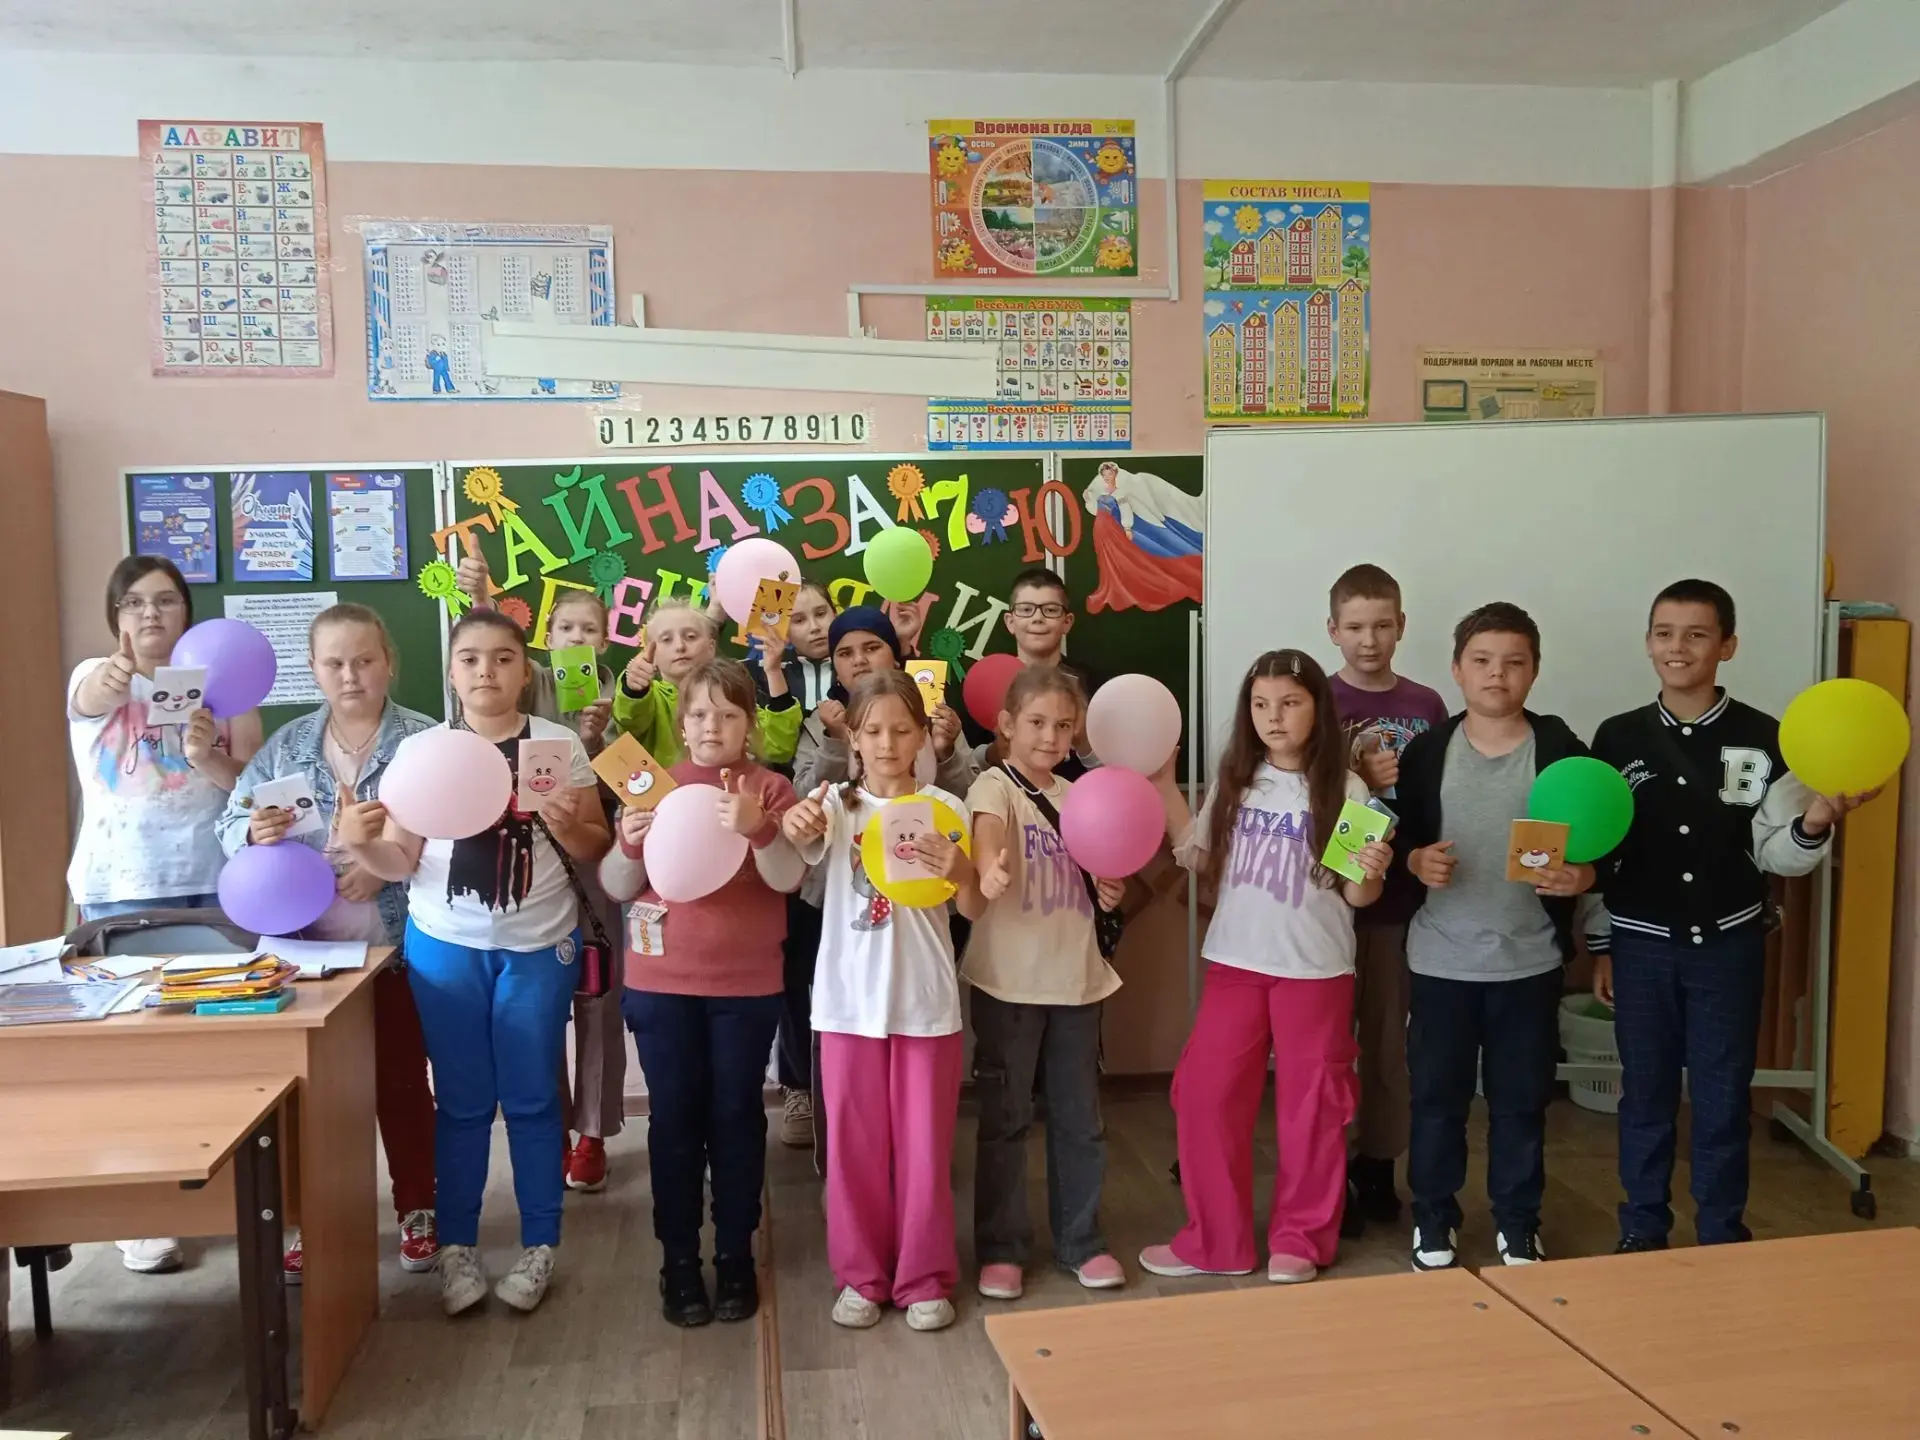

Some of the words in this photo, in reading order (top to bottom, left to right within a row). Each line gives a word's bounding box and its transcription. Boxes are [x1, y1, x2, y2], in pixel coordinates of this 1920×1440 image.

[974, 121, 1050, 135] Времена
[1052, 123, 1092, 136] года
[164, 127, 297, 147] АЛФАВИТ
[1230, 186, 1287, 198] СОСТАВ
[1292, 187, 1342, 198] ЧИСЛА
[1027, 299, 1085, 310] АЗБУКА
[1423, 357, 1478, 366] ПОДДЕРЖИВАЙ
[1480, 358, 1514, 367] ПОРЯДОК
[1516, 358, 1527, 367] НА
[1529, 358, 1563, 367] РАБОЧЕМ
[1566, 359, 1594, 368] МЕСТЕ
[600, 418, 613, 444] 0
[624, 418, 634, 444] 1
[647, 418, 660, 443] 2
[669, 417, 683, 442] 3
[692, 417, 707, 442] 4
[716, 417, 730, 441] 5
[738, 416, 752, 441] 6
[761, 416, 774, 441] 7
[784, 415, 797, 441] 8
[806, 415, 820, 440] 9
[431, 464, 760, 597] ТАЙНА
[783, 474, 898, 560] ЗА
[244, 550, 286, 558] МЕЧТАЕМ
[1718, 746, 1772, 807] B
